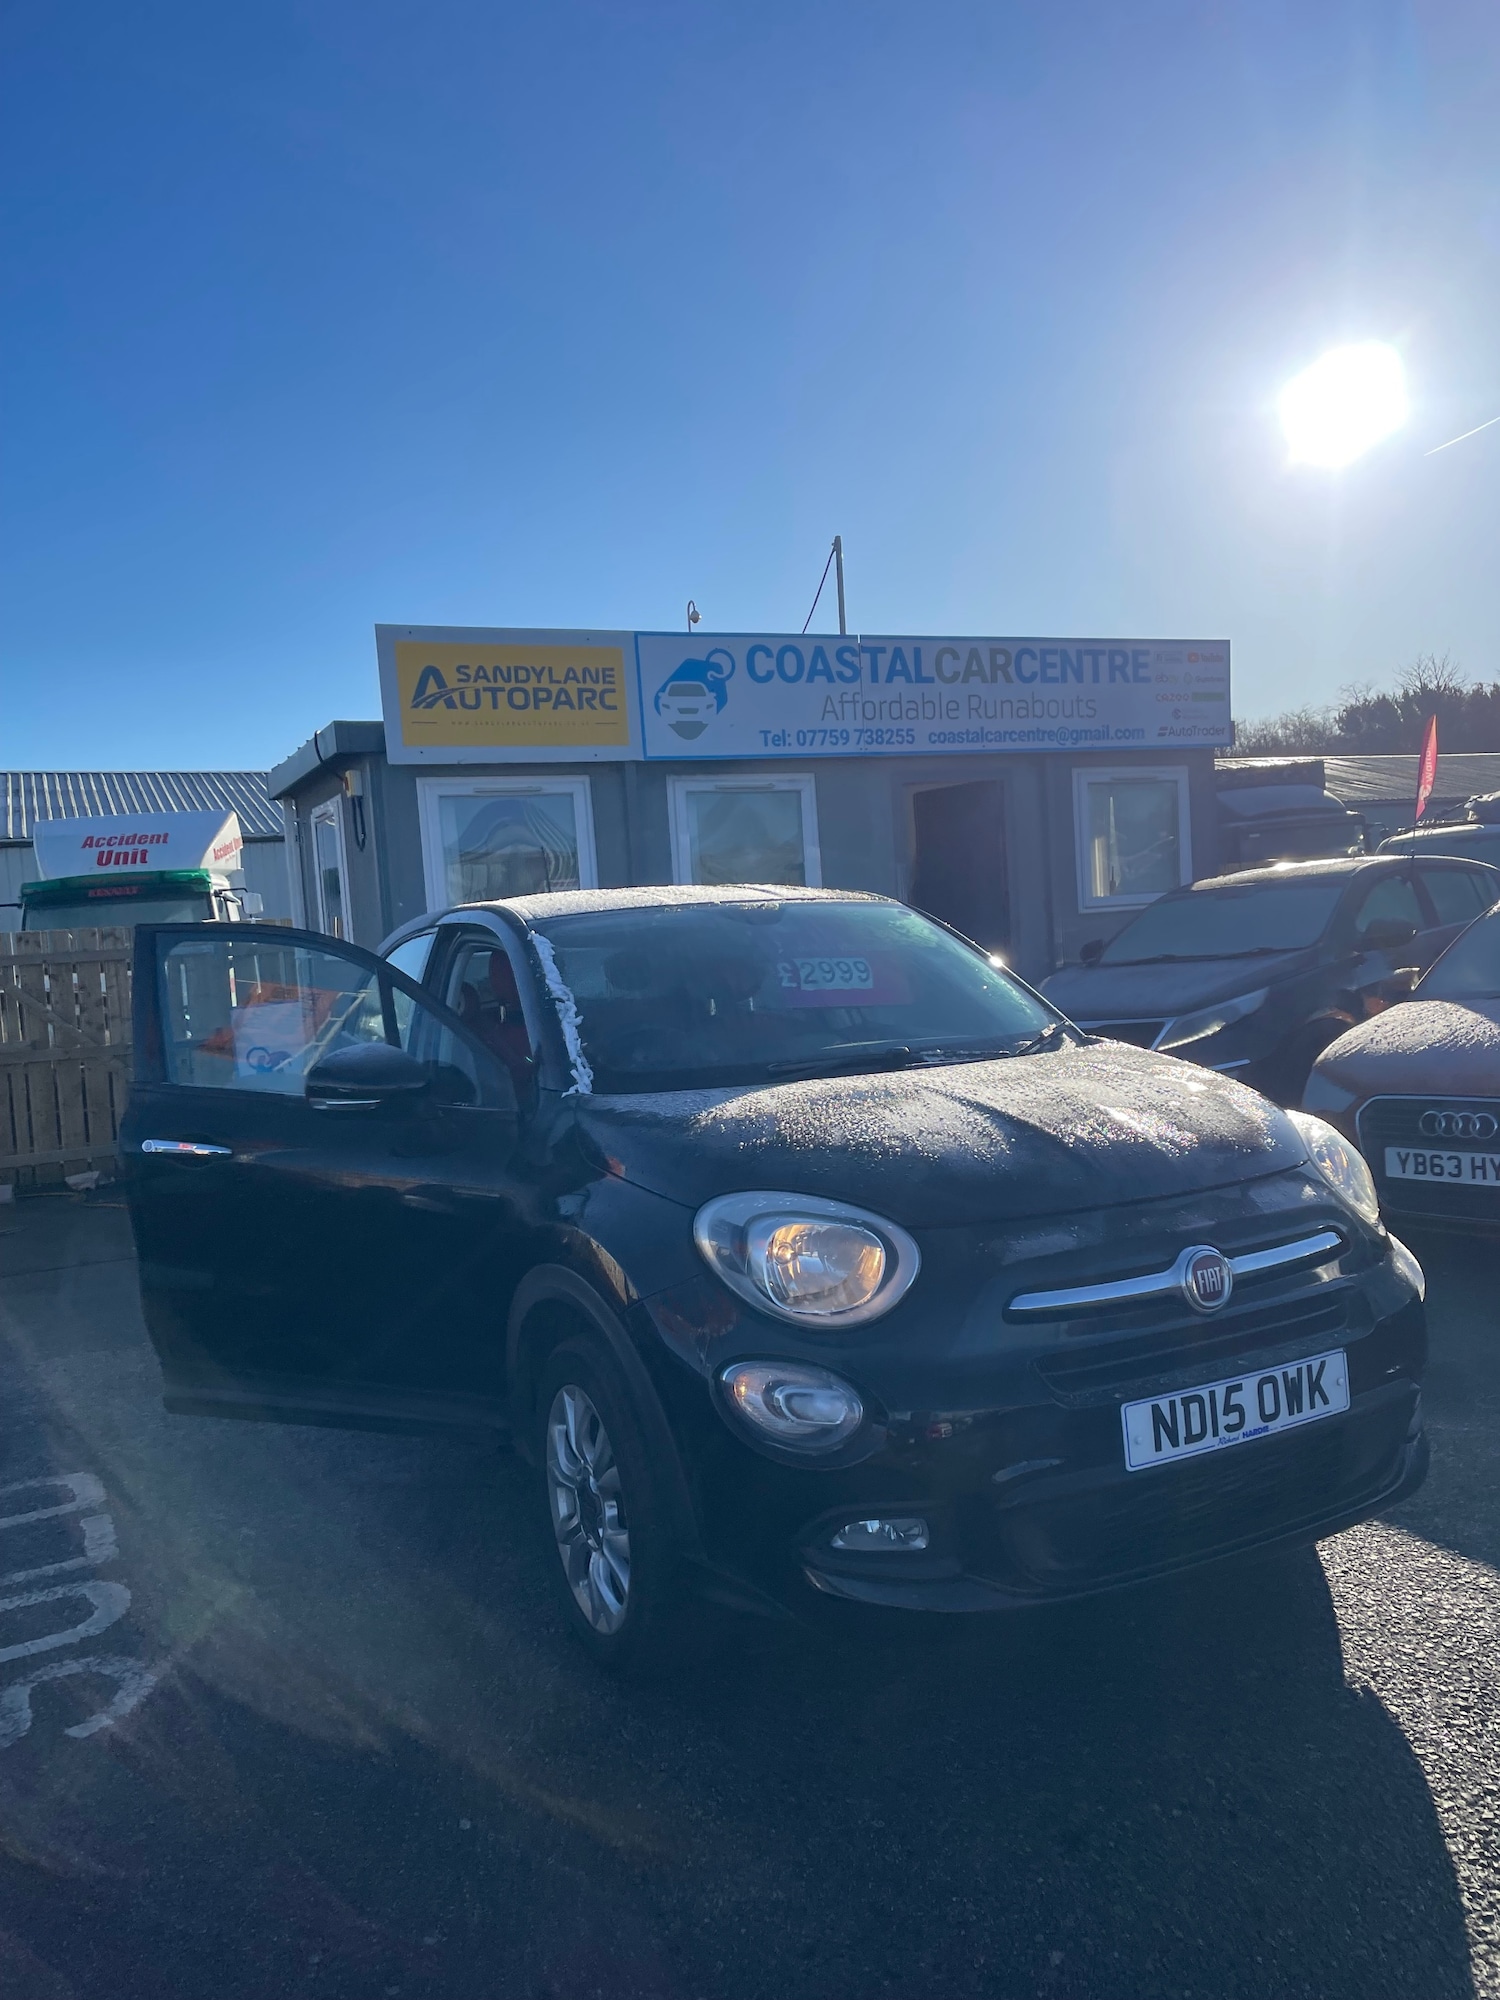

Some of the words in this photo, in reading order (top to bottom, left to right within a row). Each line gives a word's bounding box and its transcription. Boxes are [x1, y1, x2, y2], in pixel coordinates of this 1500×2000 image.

[456, 664, 616, 685] SANDYLANE
[746, 644, 1152, 684] COASTALCARCENTRE
[821, 691, 960, 721] Affordable
[968, 691, 1097, 720] Runabouts
[759, 729, 792, 747] Tel:
[796, 729, 850, 746] 07759
[854, 728, 915, 745] 738255
[928, 724, 1146, 746] coastalcarcentre@gmail.com
[1168, 725, 1226, 736] AutoTrader
[81, 832, 169, 849] Accident
[96, 848, 149, 867] Unit
[1396, 1151, 1463, 1178] YB63
[1470, 1156, 1500, 1181] HY
[1197, 1266, 1222, 1294] FIAT
[1151, 1383, 1246, 1453] ND15
[1257, 1360, 1330, 1424] OWK
